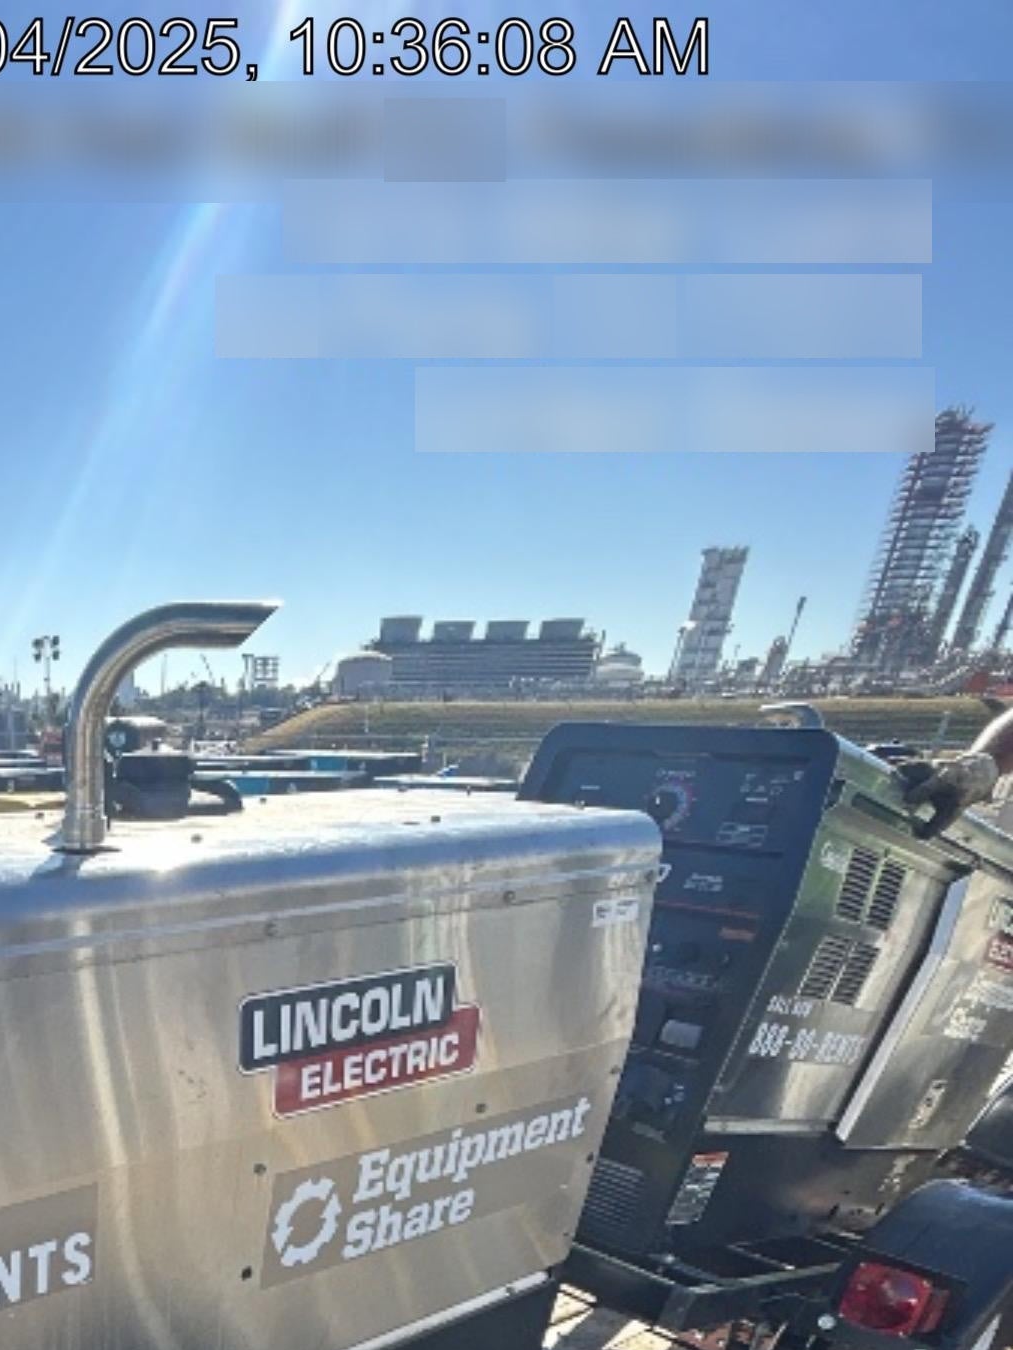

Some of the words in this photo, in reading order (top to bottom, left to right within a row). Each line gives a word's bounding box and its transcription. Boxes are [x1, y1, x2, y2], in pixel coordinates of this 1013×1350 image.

[252, 975, 446, 1061] LINCOLN
[300, 1032, 460, 1101] ELECTRIC
[353, 1096, 591, 1204] Equipment
[342, 1188, 475, 1260] Share
